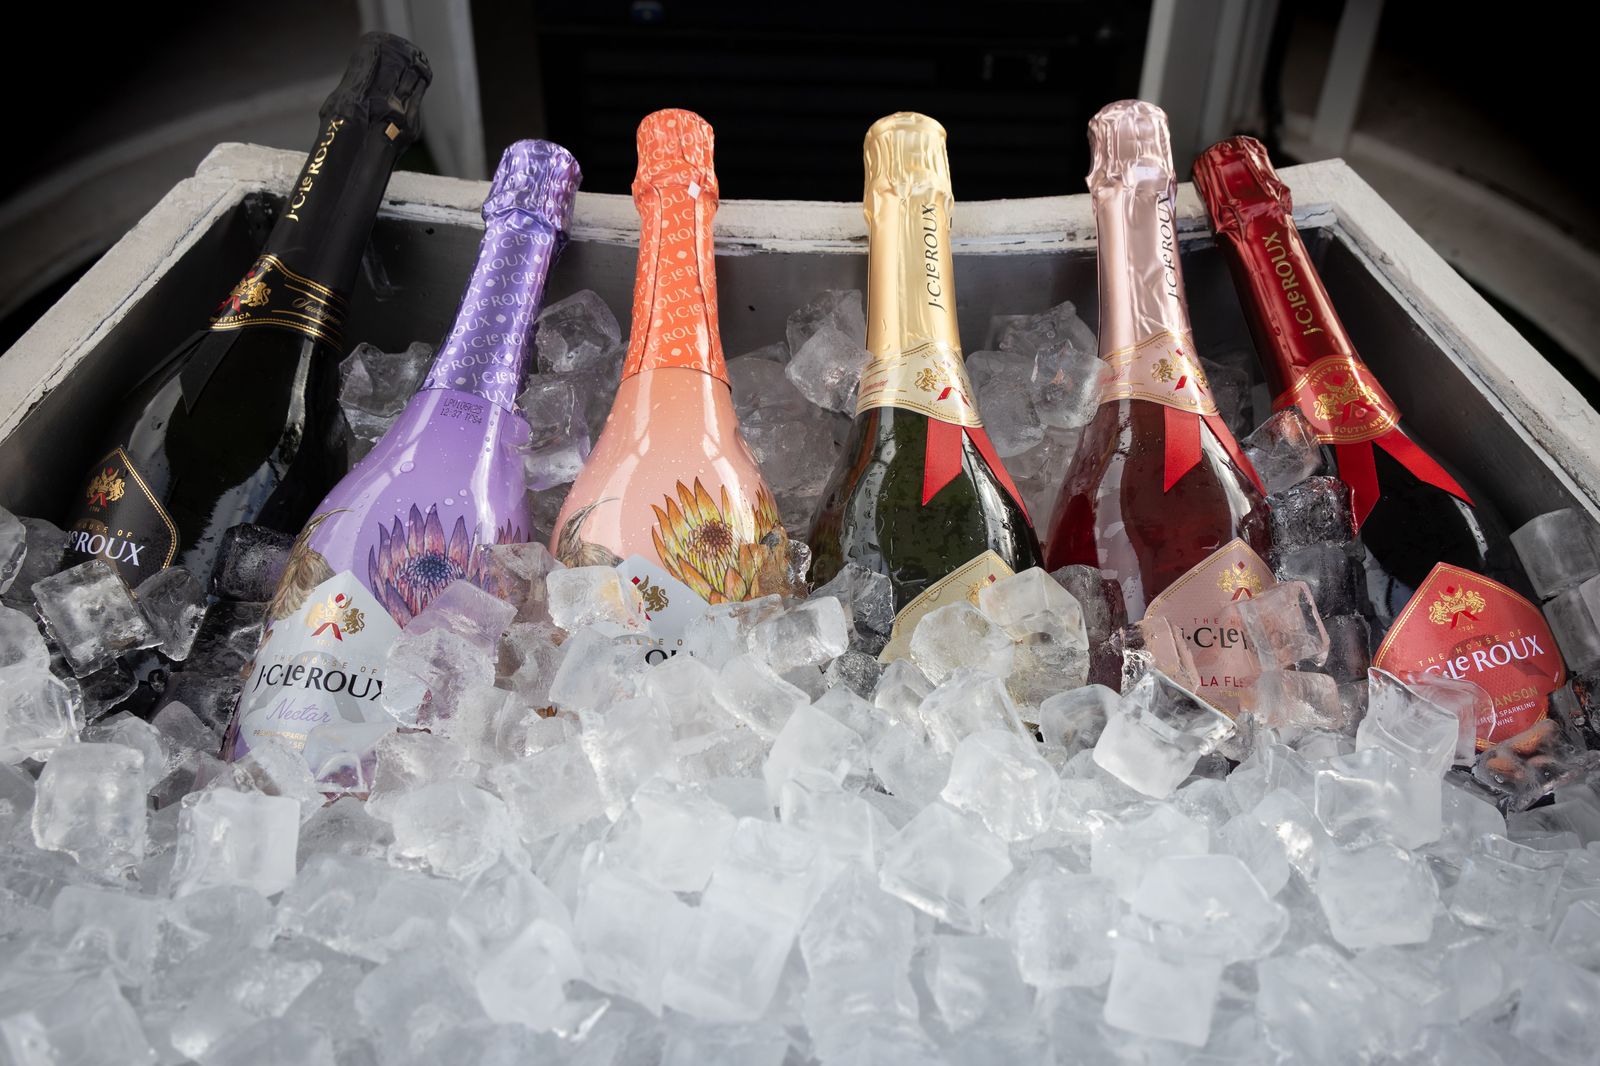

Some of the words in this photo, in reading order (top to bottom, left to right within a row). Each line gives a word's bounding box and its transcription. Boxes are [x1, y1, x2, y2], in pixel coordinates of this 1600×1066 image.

[922, 204, 940, 262] ROUX
[1261, 231, 1300, 290] ROUX
[450, 351, 502, 371] ROUX
[75, 531, 146, 567] ROUX
[1193, 617, 1219, 625] THE
[1418, 652, 1446, 668] THE
[1455, 637, 1501, 654] HOUSE
[1471, 634, 1545, 673] ROUX
[360, 665, 378, 675] OF
[1200, 675, 1219, 687] LA
[266, 698, 332, 723] Nectar
[1499, 701, 1536, 717] SPARKLING
